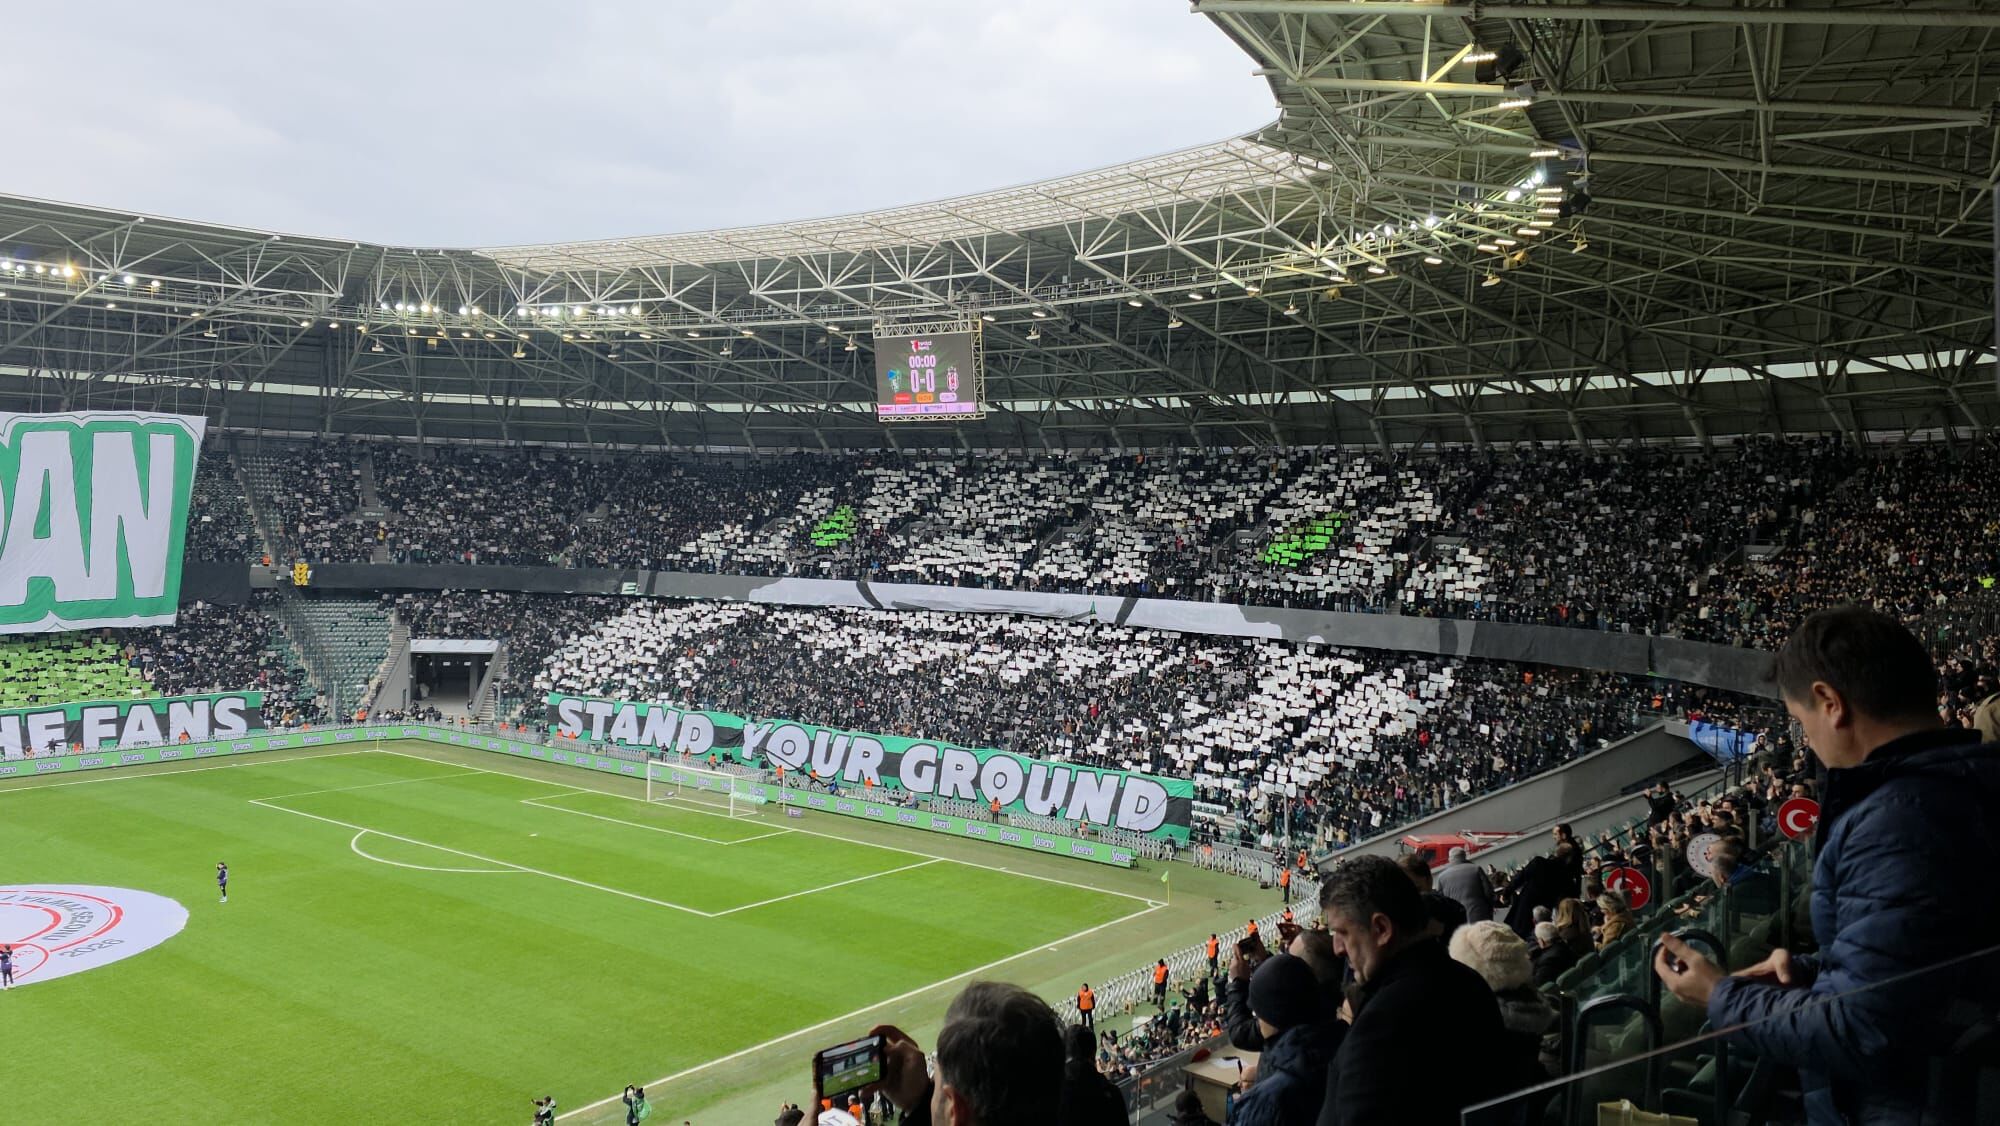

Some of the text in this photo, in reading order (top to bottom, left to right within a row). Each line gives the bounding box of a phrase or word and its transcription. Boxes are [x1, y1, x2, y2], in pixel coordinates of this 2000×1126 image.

[909, 355, 936, 368] 00:00
[0, 430, 176, 607] AN
[82, 697, 248, 750] FANS
[557, 698, 1168, 832] STAND YOUR GROUND
[59, 937, 126, 958] 2026
